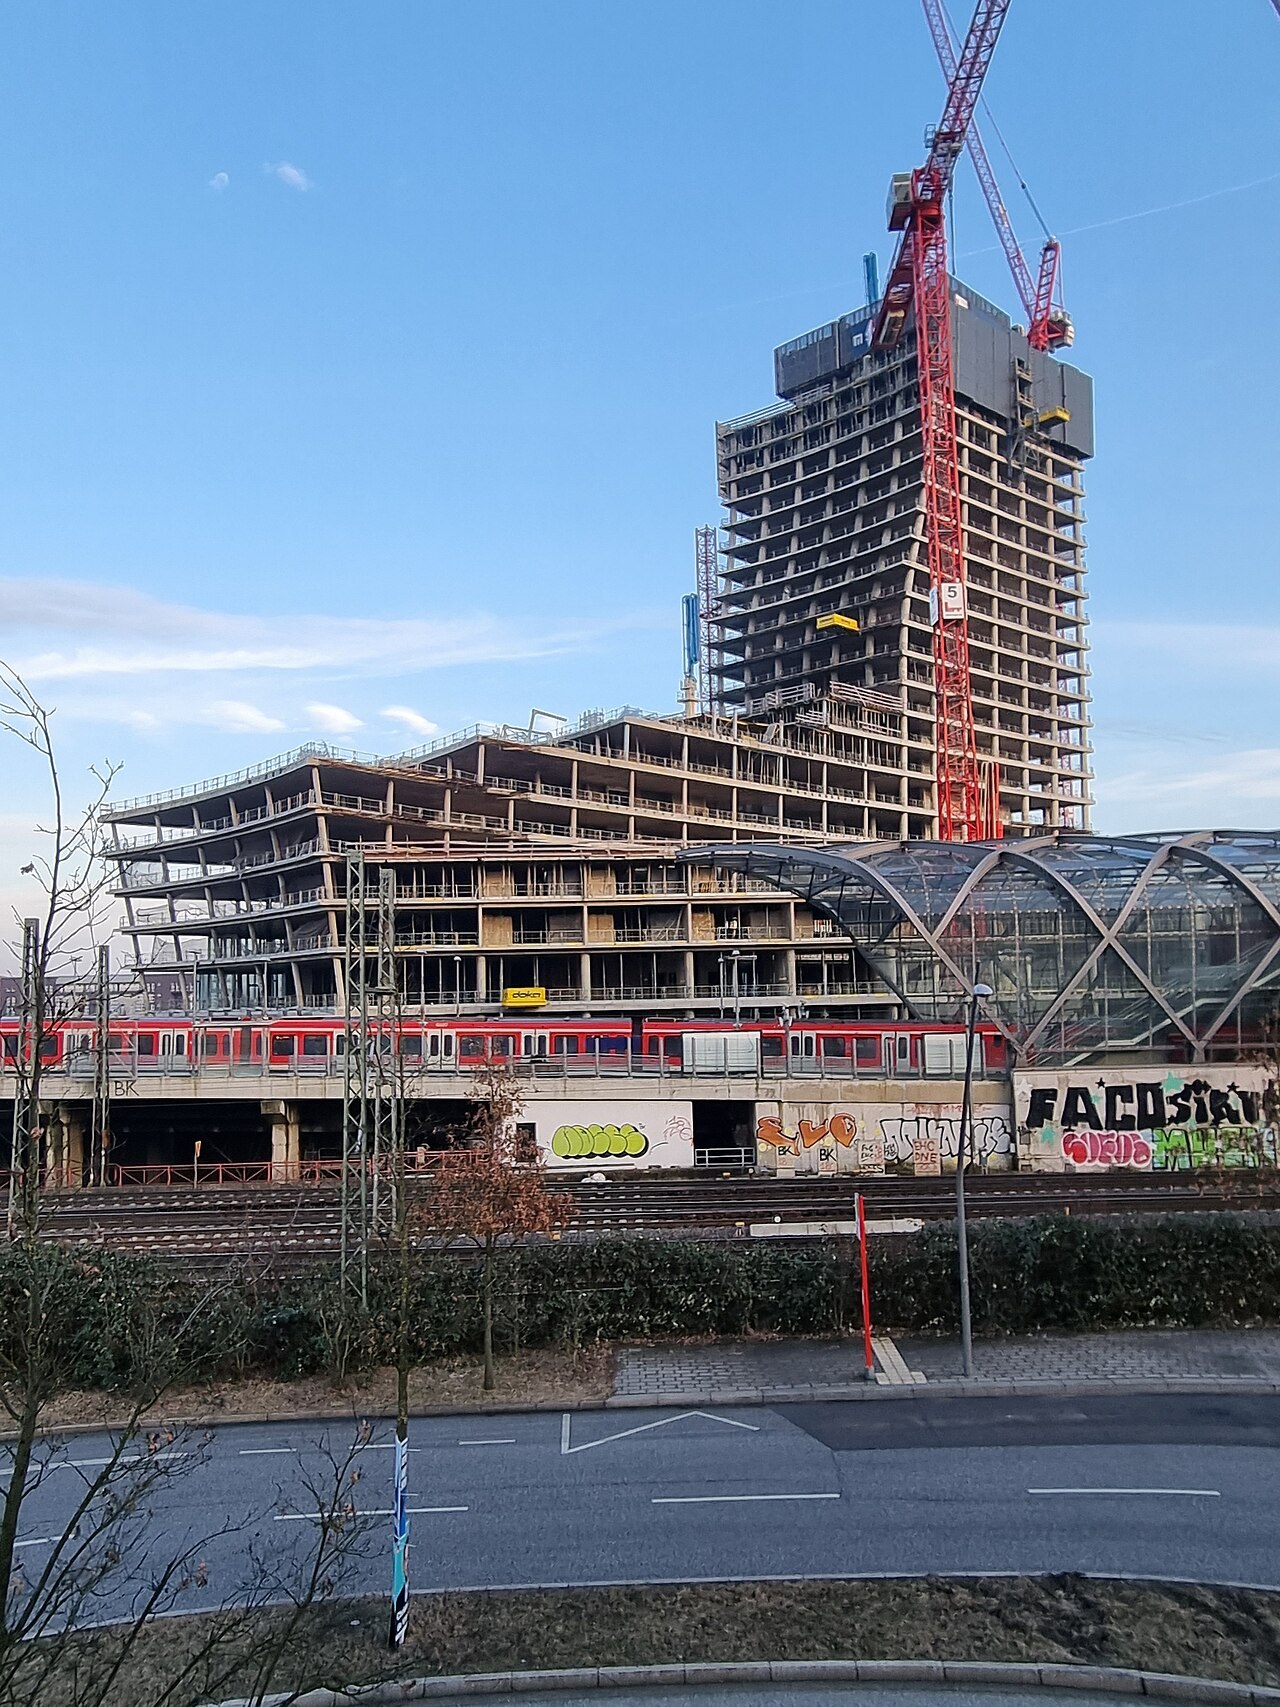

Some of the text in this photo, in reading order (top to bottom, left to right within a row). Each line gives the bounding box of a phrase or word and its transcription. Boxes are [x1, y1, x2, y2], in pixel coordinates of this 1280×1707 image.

[947, 585, 958, 598] 5
[114, 1080, 139, 1096] BK
[778, 1146, 800, 1156] BK
[820, 1149, 837, 1161] BK
